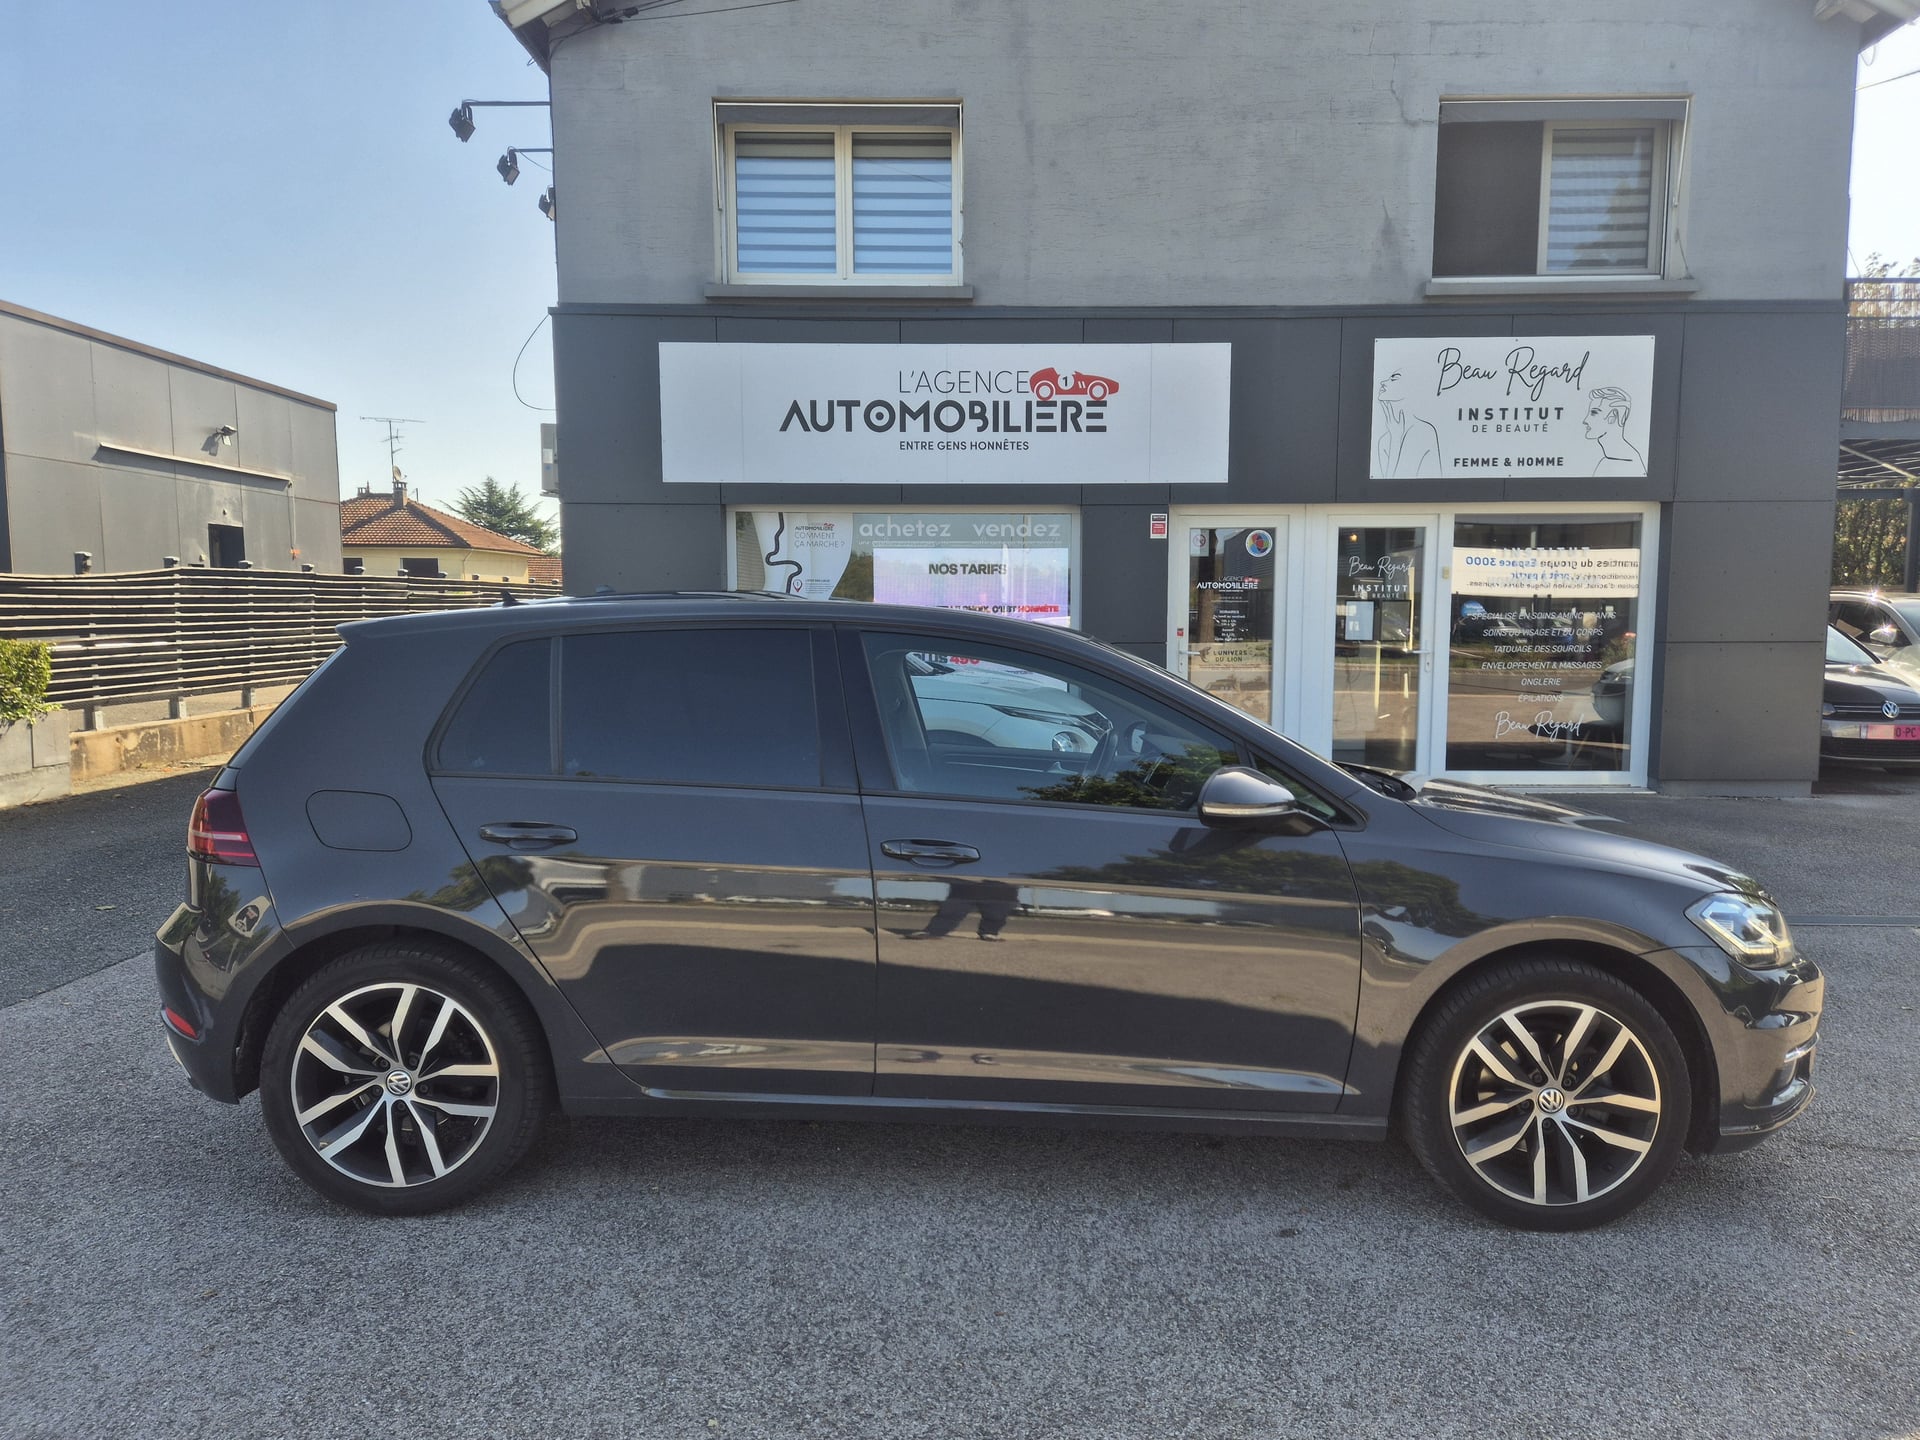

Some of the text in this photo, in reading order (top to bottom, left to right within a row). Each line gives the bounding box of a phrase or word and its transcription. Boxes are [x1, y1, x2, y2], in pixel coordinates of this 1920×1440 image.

[1436, 346, 1590, 402] Beau Regard
[899, 370, 1030, 394] L'AGENCE
[1061, 376, 1069, 387] 1
[1457, 407, 1565, 421] INSTITUT
[1472, 421, 1549, 433] DE BEAUTÉ
[899, 438, 1030, 451] ENTRE GENS HONNÊTES
[1453, 456, 1564, 468] FEMME & HOMME
[858, 515, 1061, 538] achetez vendez
[794, 532, 836, 540] COMMENT
[794, 541, 805, 549] ÇA
[928, 563, 1007, 575] NOS TARIFS
[1348, 555, 1414, 580] Beau Regard
[1352, 584, 1408, 592] INSTITUT
[1483, 629, 1507, 637] SOINS
[1576, 628, 1604, 637] CORPS
[1494, 644, 1592, 653] TATOUAGE DES SOURCILS
[1481, 662, 1551, 670] ENVELOPPEMENT
[1559, 661, 1602, 669] MASSAGES
[1521, 678, 1562, 686] ONGLERIE
[1495, 710, 1585, 742] Beau Regard
